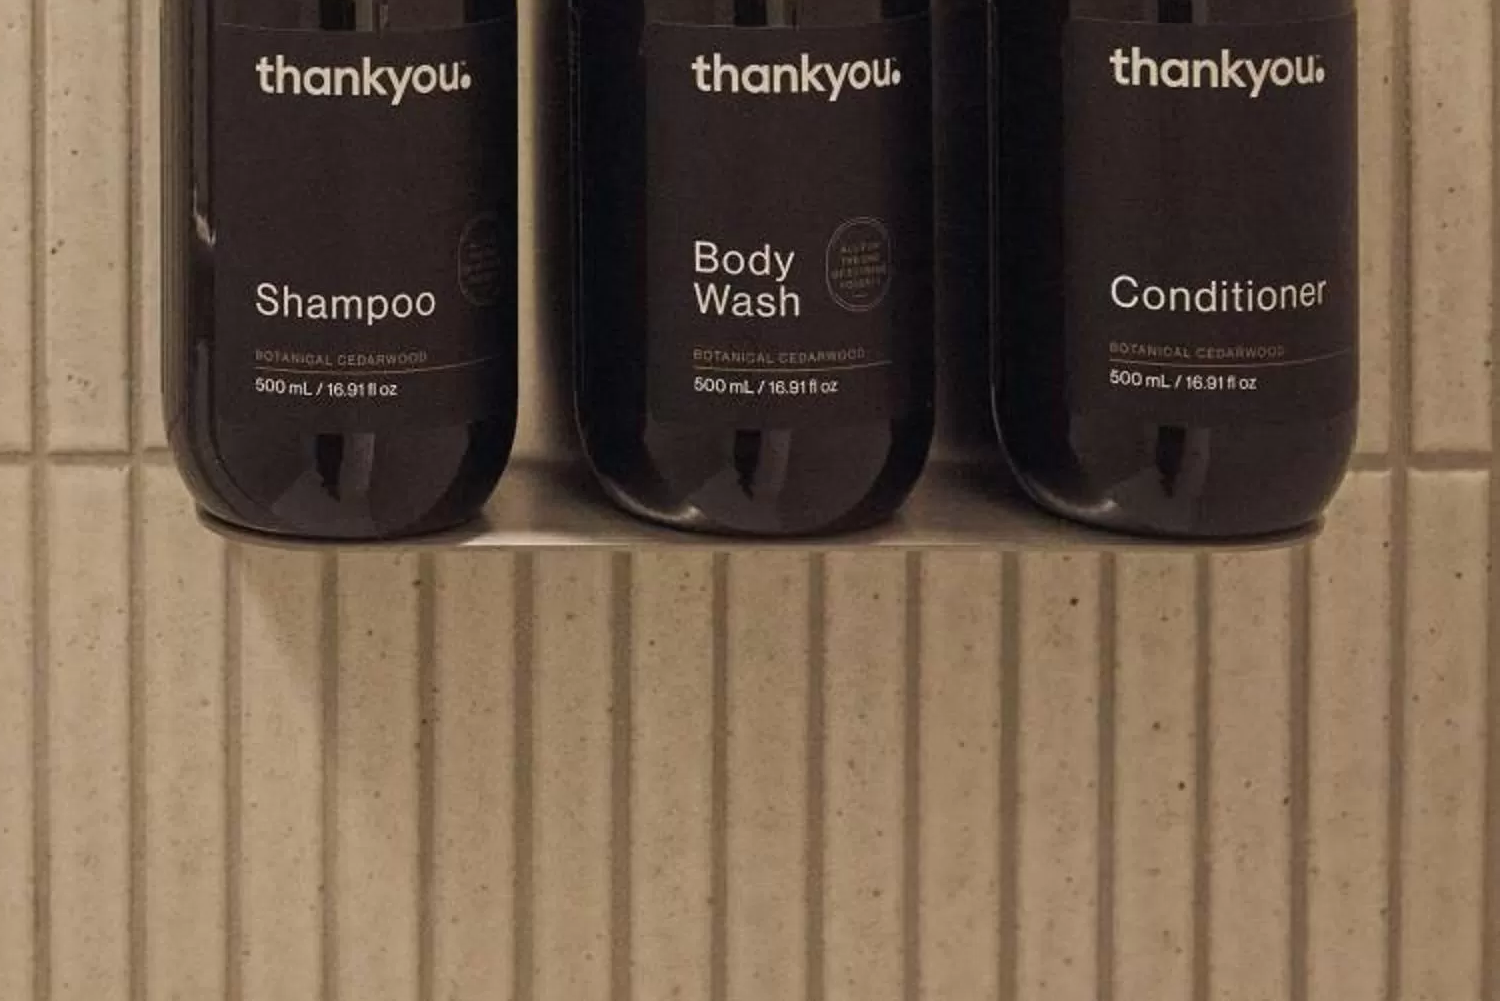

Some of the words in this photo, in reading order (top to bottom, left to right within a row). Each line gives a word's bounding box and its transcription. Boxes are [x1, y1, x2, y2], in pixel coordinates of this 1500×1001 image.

[694, 240, 795, 282] Body
[254, 282, 436, 326] Shampoo
[693, 281, 800, 318] Wash
[1110, 274, 1327, 313] Conditioner
[255, 349, 333, 367] BOTANICAL
[337, 350, 428, 367] CEDARWOOD
[692, 347, 776, 365] BOTANICAL
[779, 346, 866, 364] CEDARWOOD
[1108, 341, 1190, 359] BOTANICAL
[1194, 343, 1285, 360] CEDARWOOD
[254, 377, 286, 395] 500
[289, 381, 313, 397] mL
[316, 383, 323, 397] /
[326, 381, 366, 398] 16.91
[368, 381, 377, 397] fl
[379, 383, 398, 397] oz
[694, 376, 727, 393] 500
[729, 379, 755, 394] mL
[757, 379, 765, 394] /
[768, 379, 806, 395] 16.91
[809, 378, 817, 394] fl
[821, 380, 839, 394] oz
[1109, 369, 1142, 386] 500
[1145, 374, 1171, 389] mL
[1175, 374, 1182, 389] /
[1186, 374, 1224, 390] 16.91
[1227, 374, 1236, 389] fl
[1238, 377, 1257, 390] oz
